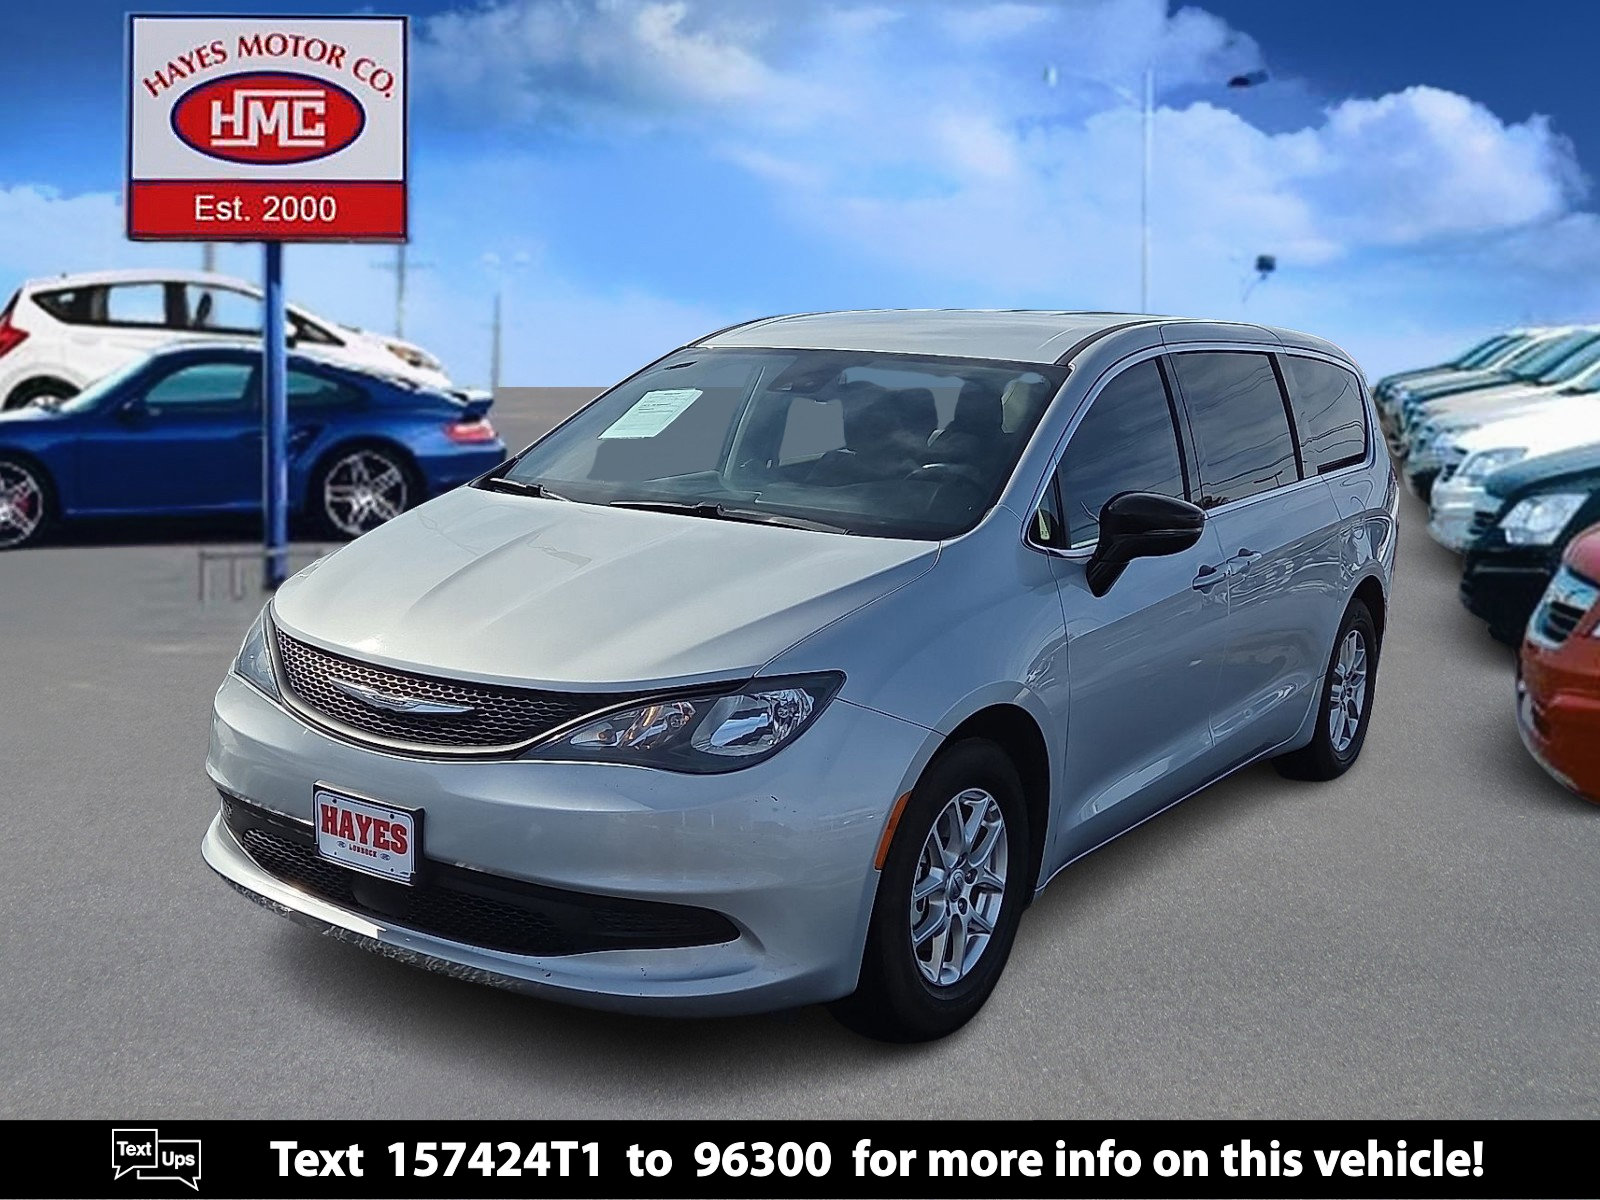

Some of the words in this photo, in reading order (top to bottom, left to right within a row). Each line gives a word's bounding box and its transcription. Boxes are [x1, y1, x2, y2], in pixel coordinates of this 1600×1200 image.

[142, 40, 228, 97] HAYES
[237, 33, 346, 70] MOTOR
[352, 57, 394, 98] CO.
[210, 89, 326, 147] HMC
[194, 195, 250, 221] Est.
[262, 195, 337, 222] 2000
[320, 803, 408, 855] HAYES
